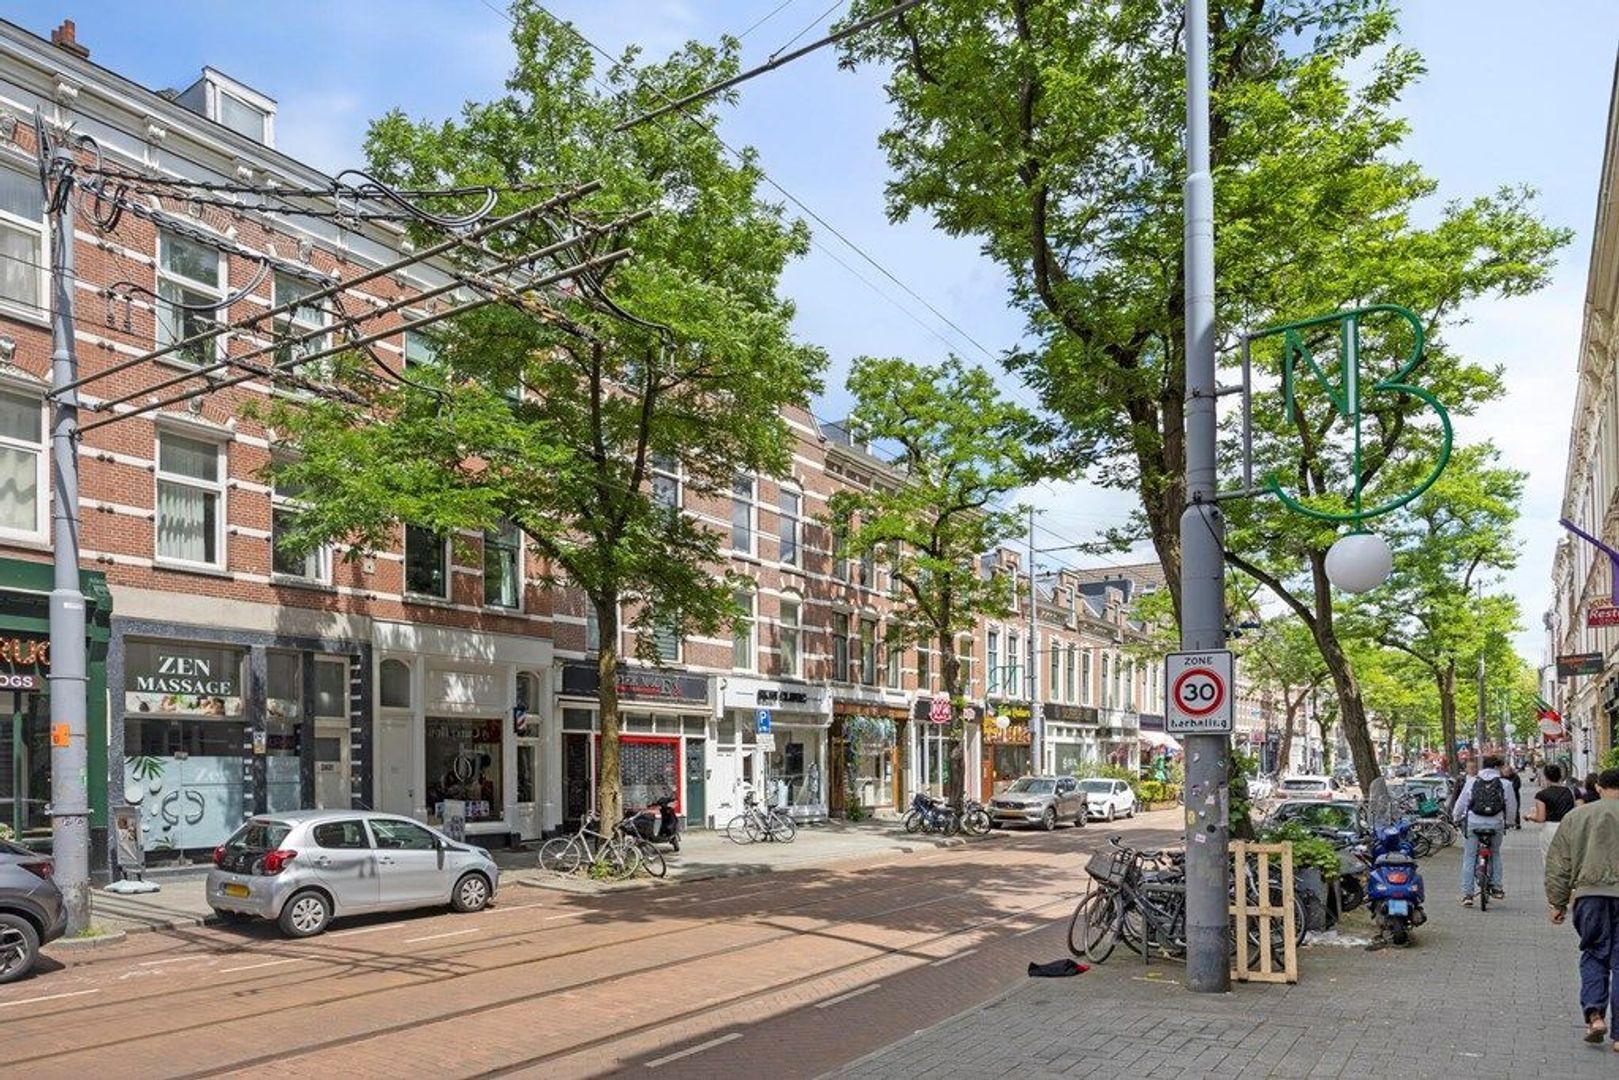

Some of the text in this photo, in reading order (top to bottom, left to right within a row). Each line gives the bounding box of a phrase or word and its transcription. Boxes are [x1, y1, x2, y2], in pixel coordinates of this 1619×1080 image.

[1590, 609, 1619, 619] Rest
[158, 656, 210, 676] ZEN
[1184, 657, 1213, 666] ZONE
[0, 675, 33, 687] OGS
[137, 676, 231, 695] MASSAGE
[1184, 684, 1215, 701] 30
